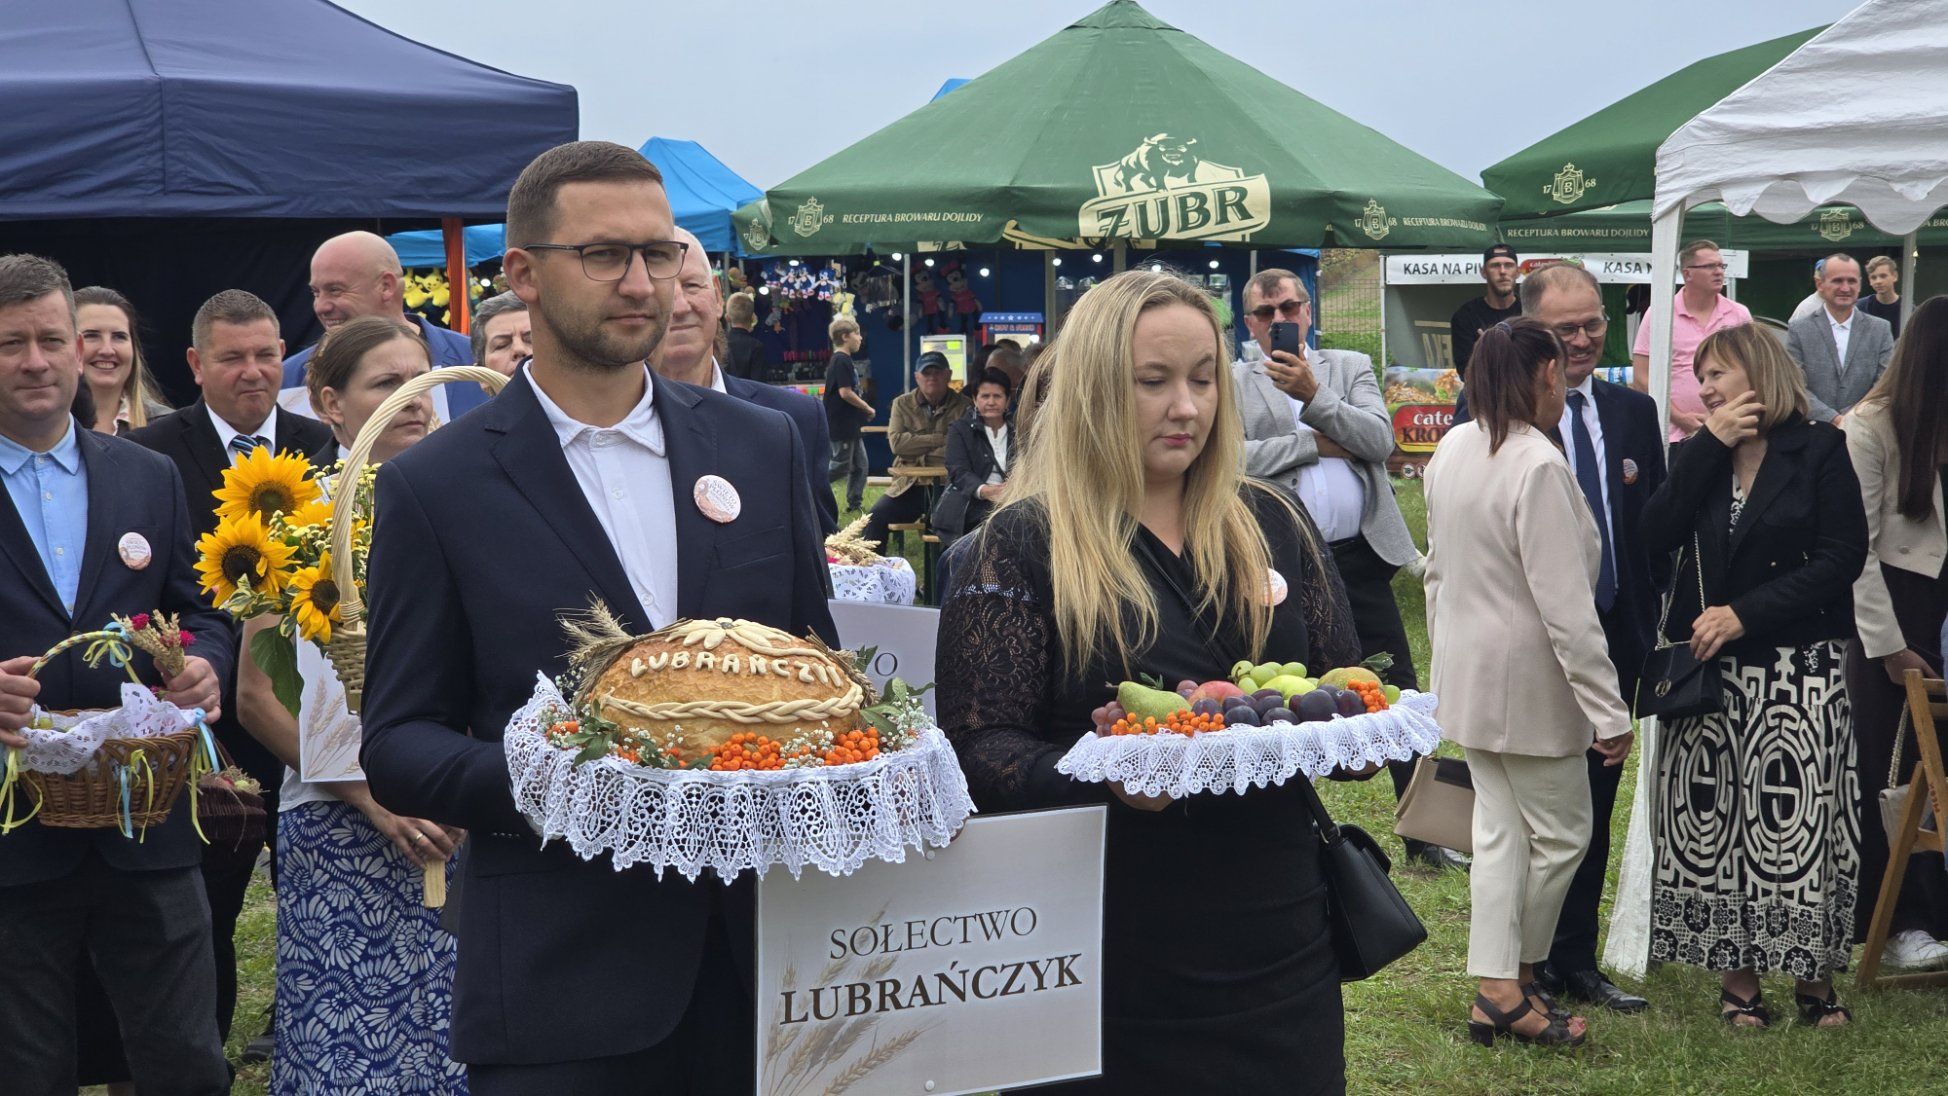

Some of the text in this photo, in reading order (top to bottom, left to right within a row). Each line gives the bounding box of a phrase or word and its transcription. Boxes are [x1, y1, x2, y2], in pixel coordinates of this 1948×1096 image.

[1543, 185, 1552, 194] 17
[1585, 179, 1596, 188] 68
[788, 216, 796, 225] 17
[823, 214, 834, 223] 68
[842, 213, 892, 223] RECEPTURA
[894, 212, 940, 222] BROWARU
[942, 211, 984, 222] DOJLIDY
[1388, 216, 1397, 227] 68
[1507, 229, 1650, 239] RECEPTURA BROWARU DOJLIDY
[1403, 262, 1484, 275] KASA NA PI
[1603, 261, 1643, 274] KASA
[830, 906, 1037, 960] SOŁECTWO
[779, 953, 1083, 1025] LUBRAŃCZYK
